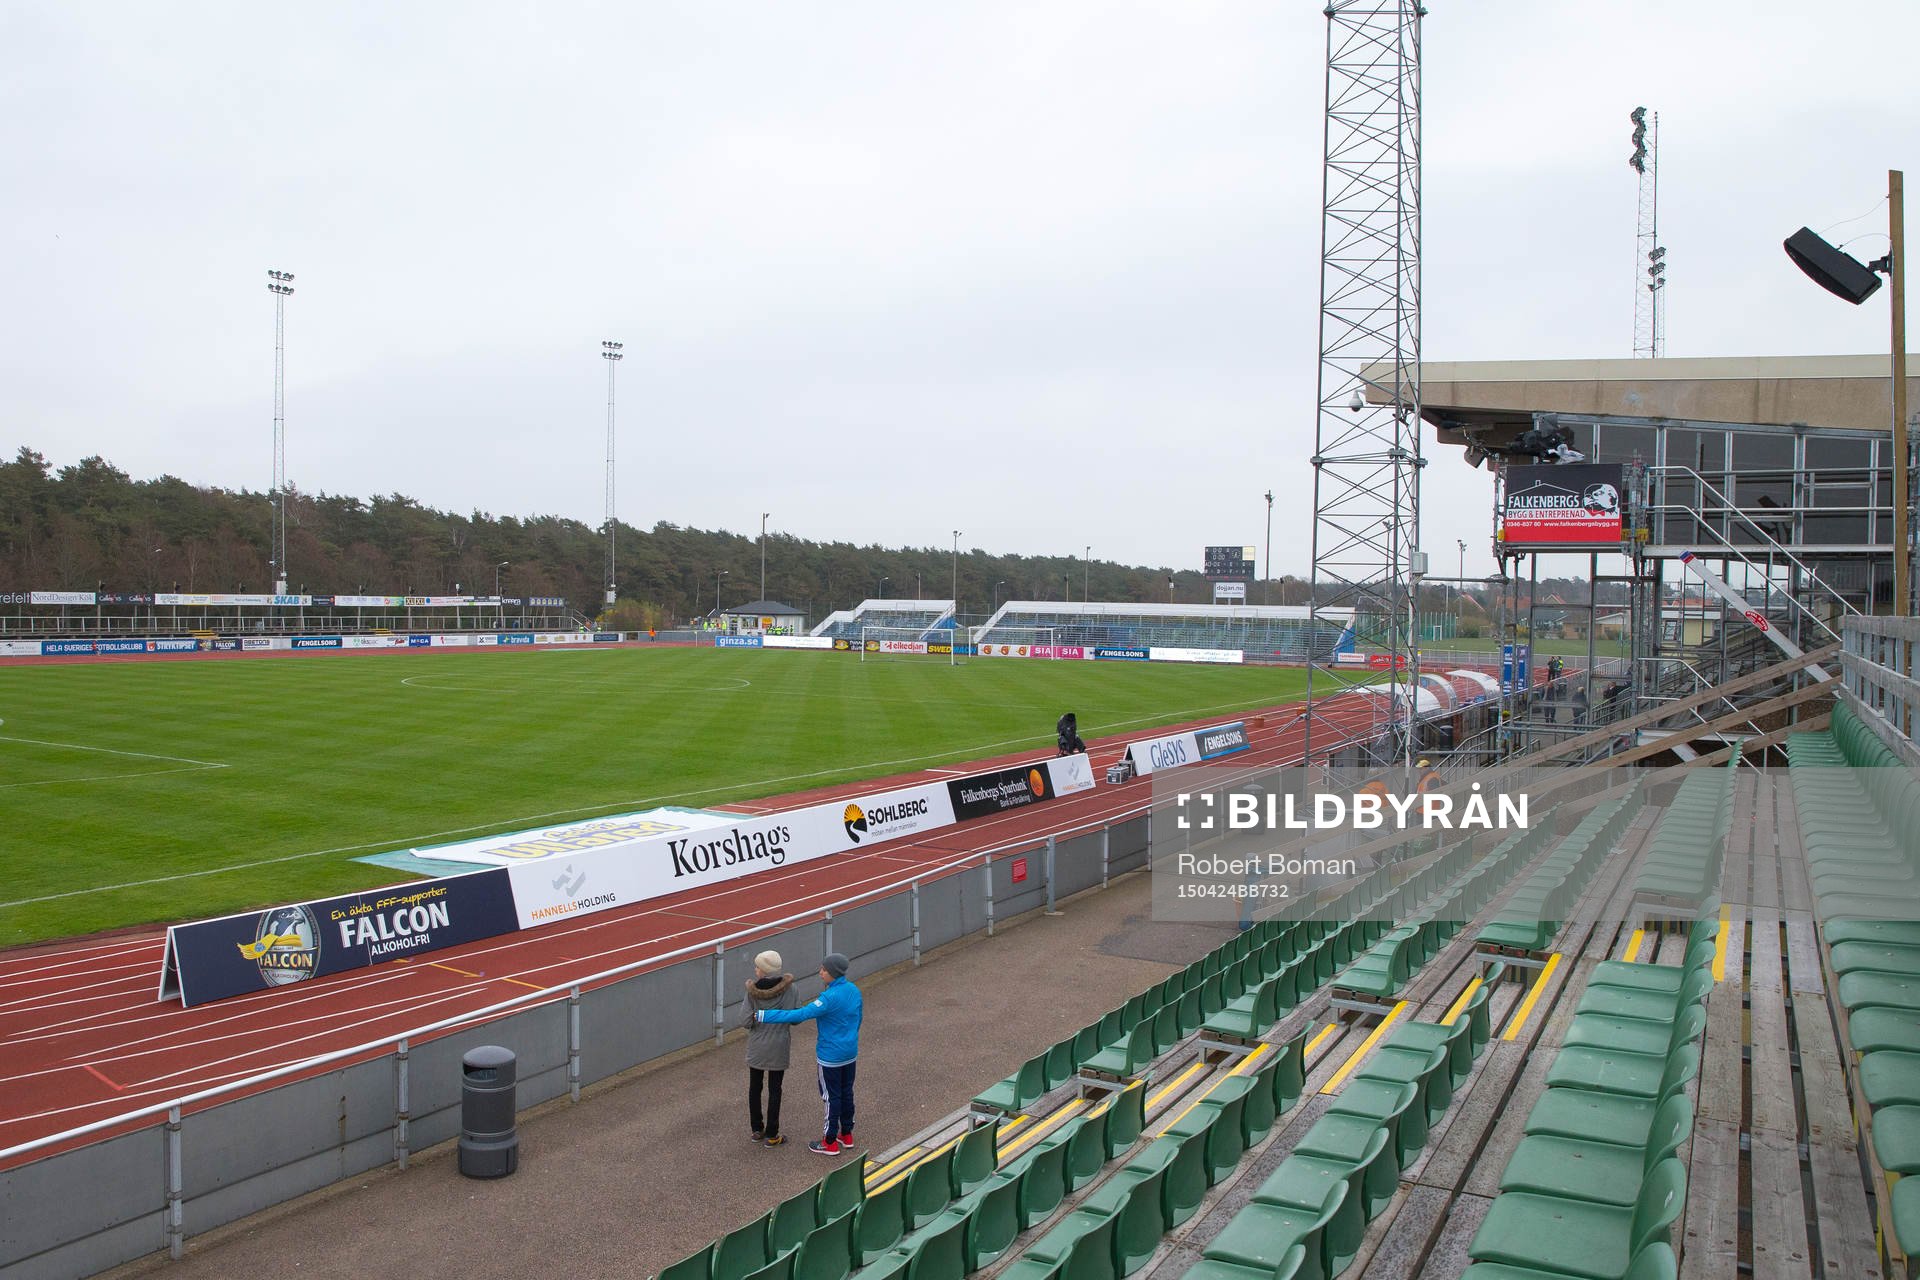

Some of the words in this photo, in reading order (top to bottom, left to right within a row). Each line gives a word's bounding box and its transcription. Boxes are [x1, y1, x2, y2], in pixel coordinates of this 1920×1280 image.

[1508, 495, 1579, 508] FALKENBERGS
[1508, 510, 1527, 518] BYGG
[1529, 510, 1533, 518] &
[1535, 509, 1585, 518] ENTREPRENAD
[33, 594, 76, 603] NordDesign
[274, 596, 299, 604] SKAB
[720, 638, 758, 646] ginza.se
[1062, 648, 1079, 656] SIA
[1100, 650, 1144, 658] ENGELSONS
[961, 783, 1000, 804] Falkenbergs
[999, 779, 1028, 798] Sparbank
[868, 799, 928, 826] SOHLBERG
[667, 824, 790, 877] Korshag's
[331, 910, 346, 920] En
[349, 904, 373, 914] äkta
[338, 901, 450, 948] FALCON
[371, 933, 430, 956] ALKOHOLFRI
